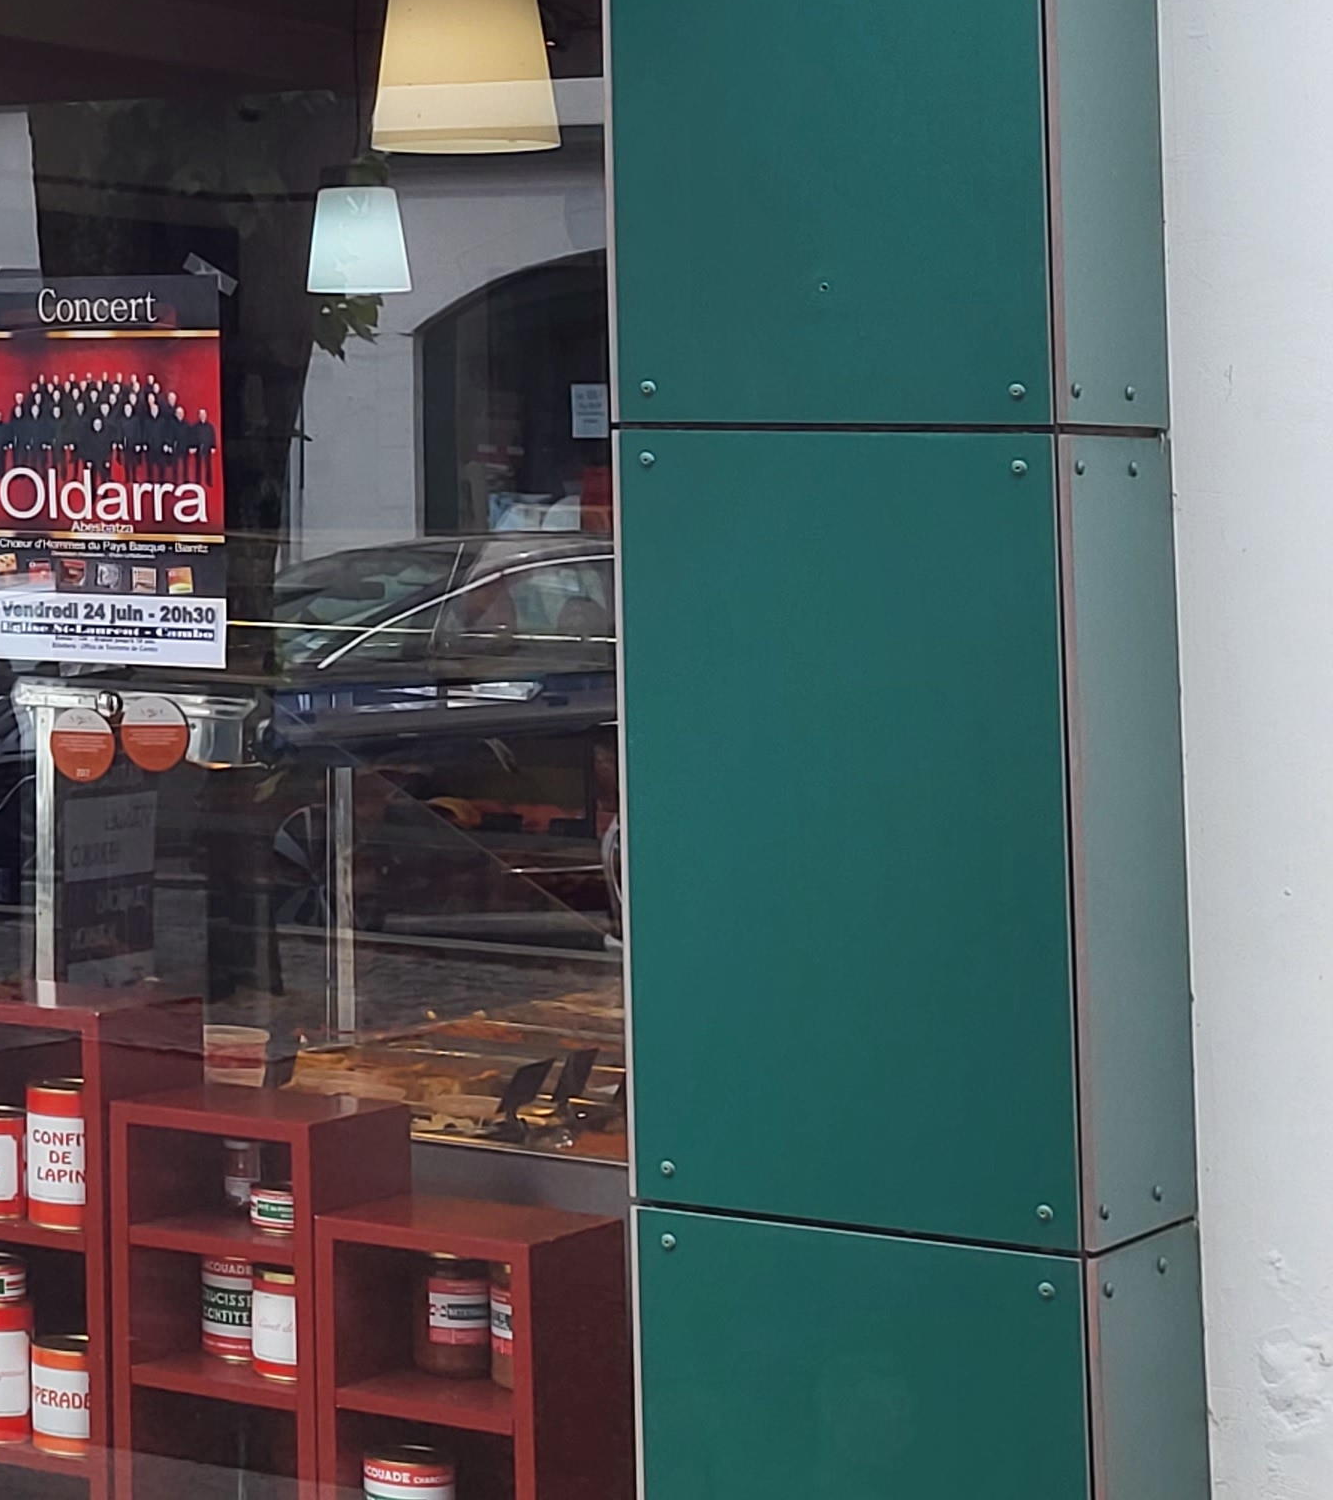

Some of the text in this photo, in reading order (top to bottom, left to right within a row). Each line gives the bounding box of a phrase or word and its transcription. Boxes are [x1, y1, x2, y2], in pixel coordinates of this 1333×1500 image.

[37, 288, 157, 323] Concert
[87, 540, 101, 551] du
[102, 541, 127, 554] Pays
[2, 601, 78, 619] Vendredi
[83, 604, 106, 620] 24
[109, 603, 144, 624] juin
[159, 606, 216, 624] 20h30
[155, 626, 214, 639] Cambo
[33, 1128, 85, 1147] CONFI
[49, 1150, 73, 1165] DE
